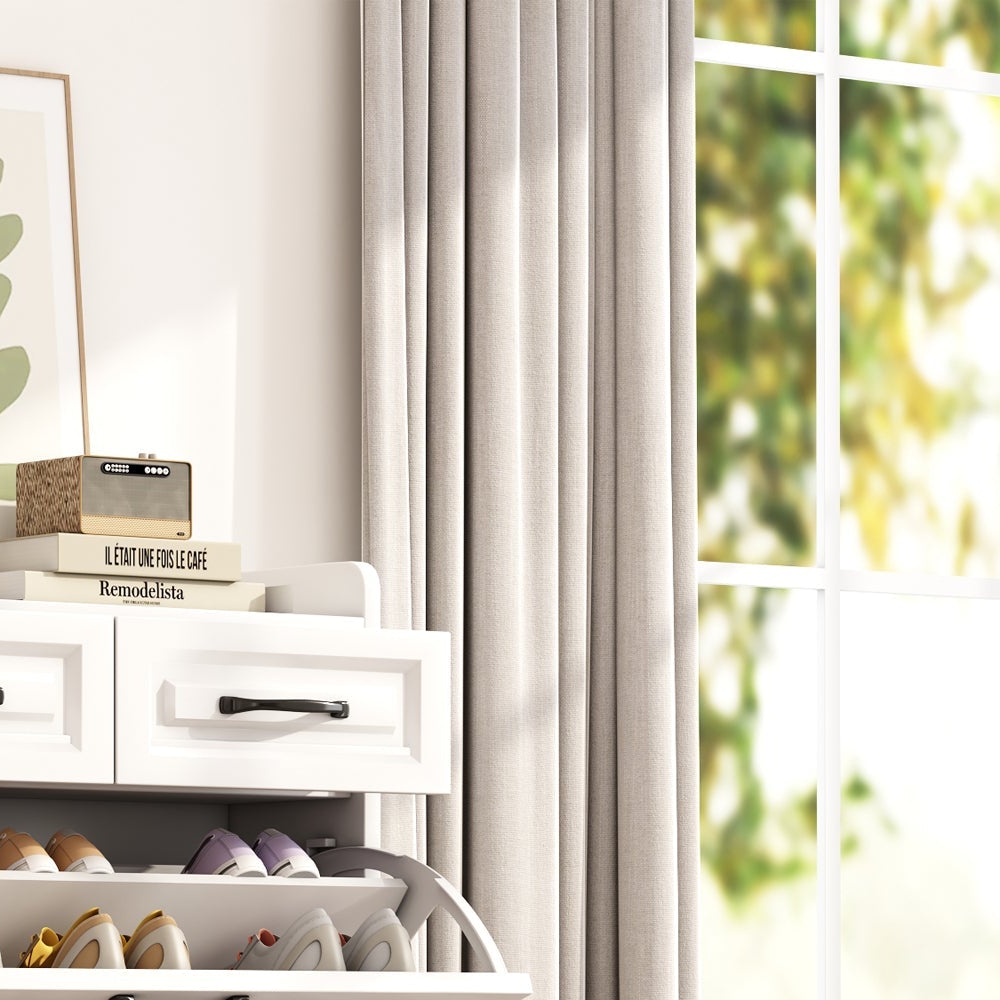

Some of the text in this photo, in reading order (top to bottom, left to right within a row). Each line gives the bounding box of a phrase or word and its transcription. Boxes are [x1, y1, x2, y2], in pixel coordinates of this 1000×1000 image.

[105, 543, 207, 570] IL ÉTAIT UNE FOIS LE CAFÉ
[99, 580, 184, 600] Remodelista
